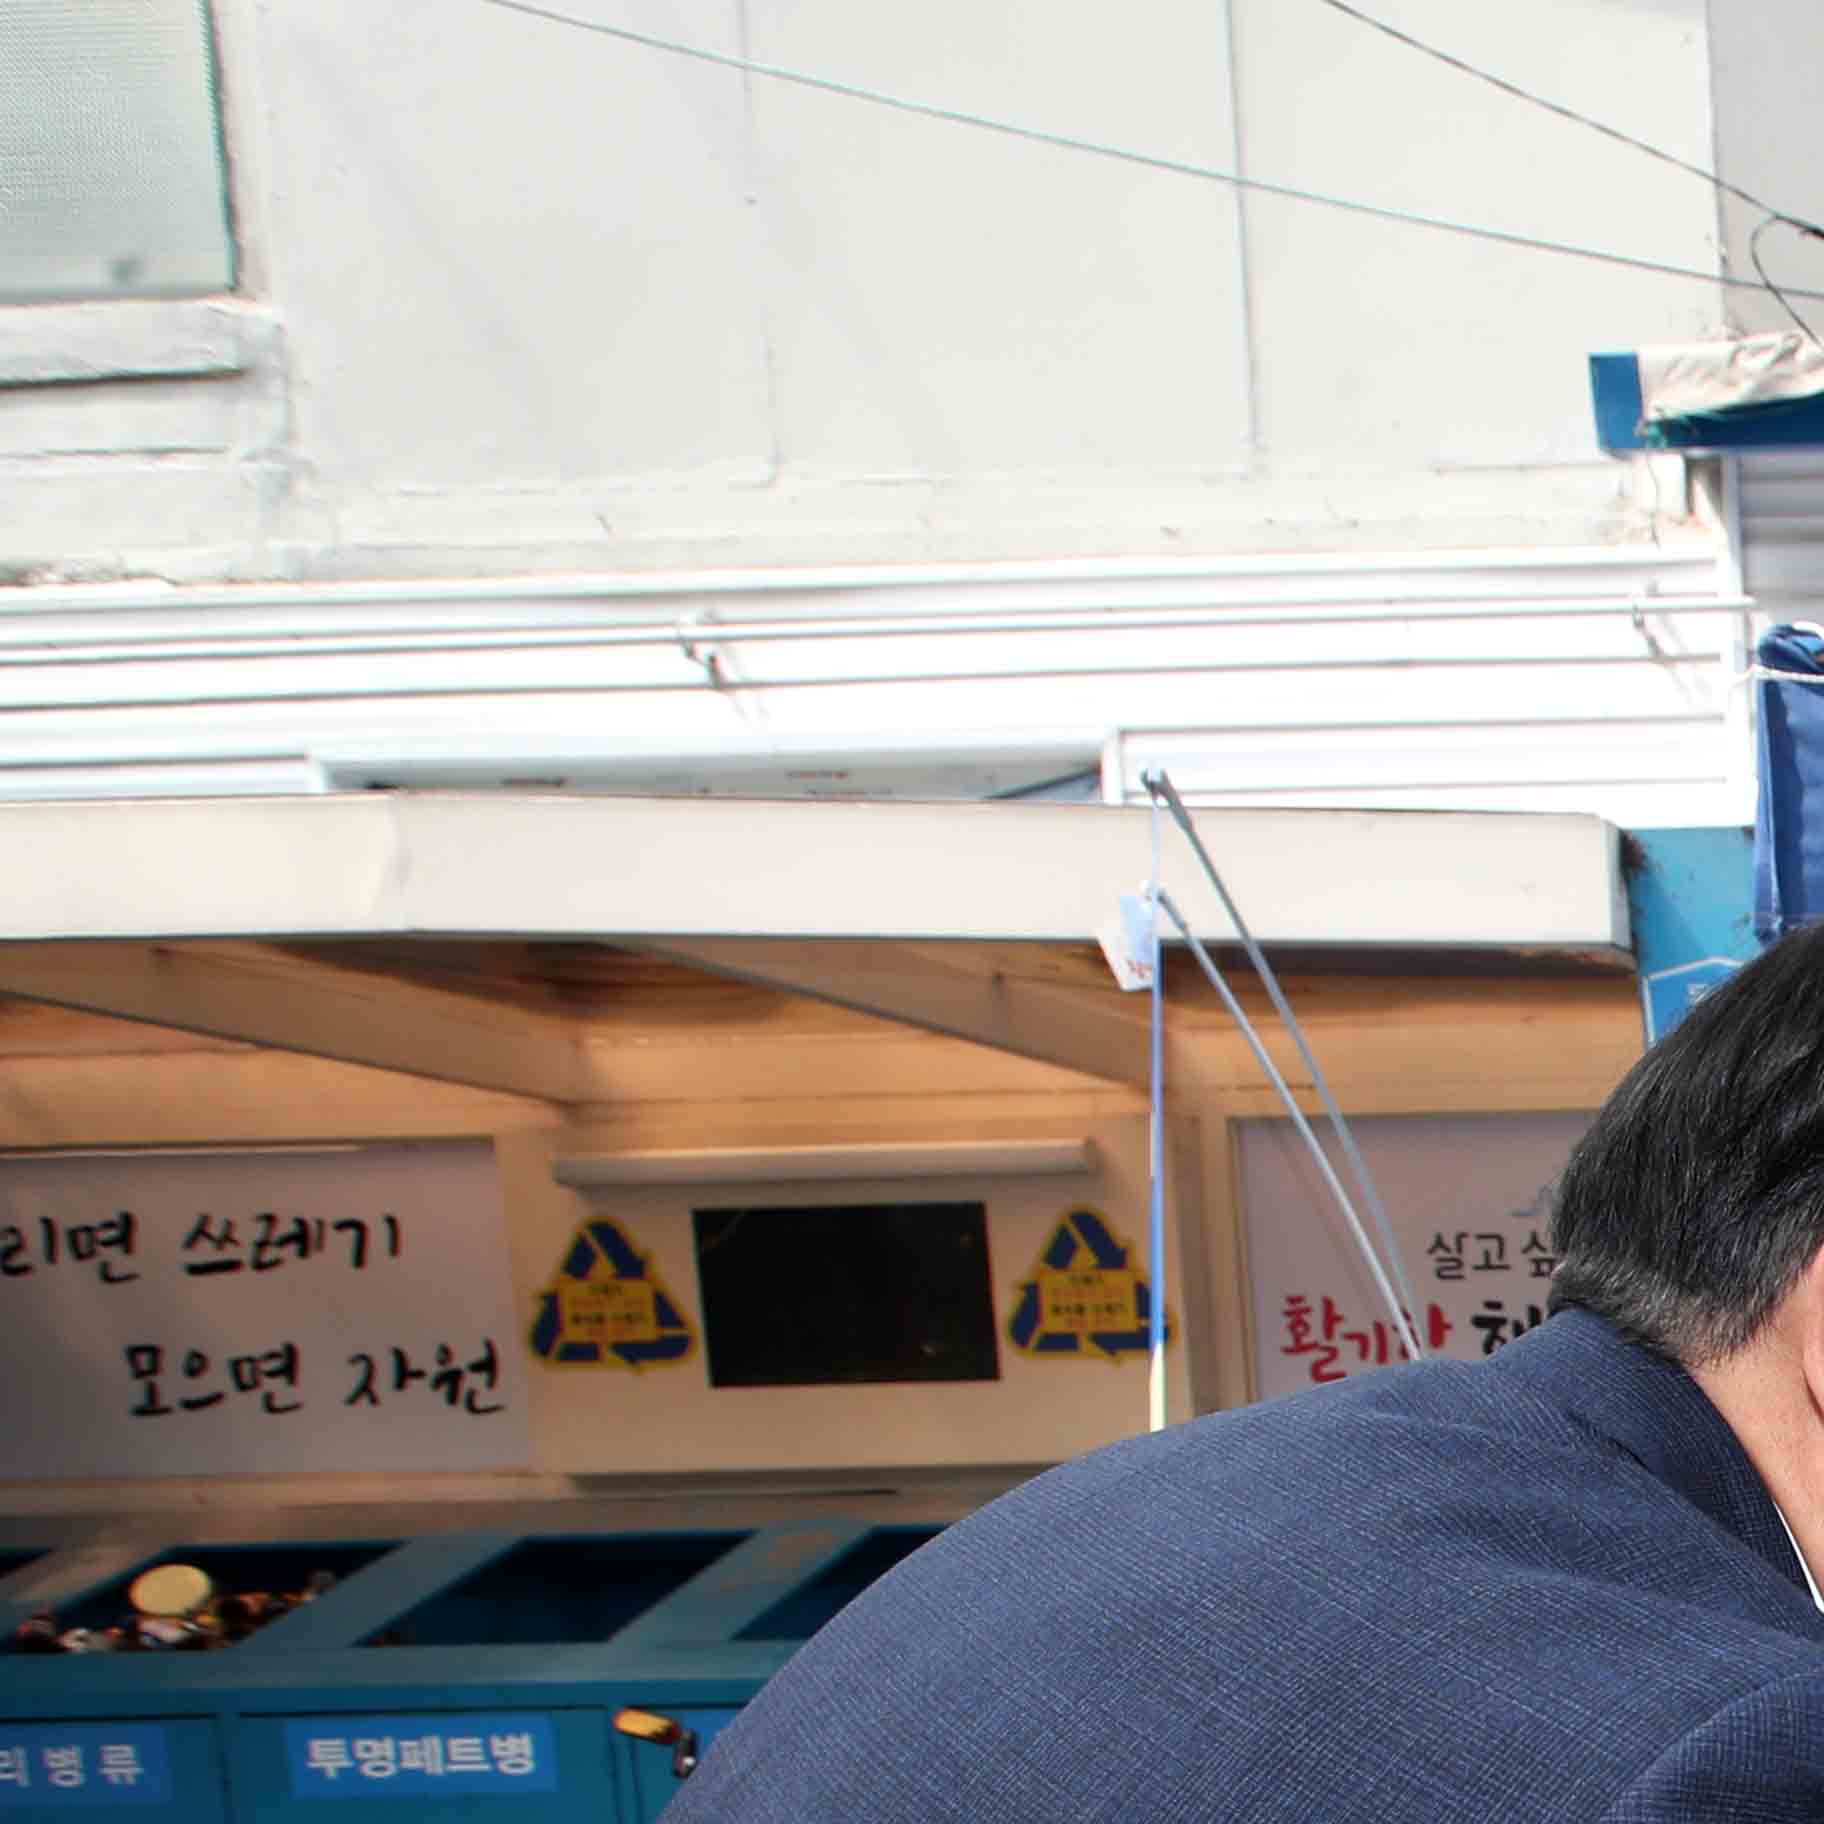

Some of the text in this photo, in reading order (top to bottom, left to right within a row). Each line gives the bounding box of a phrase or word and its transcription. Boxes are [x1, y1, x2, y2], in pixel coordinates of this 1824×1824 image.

[181, 1213, 400, 1273] 쓰레기
[1427, 1232, 1511, 1280] 살고
[126, 1339, 504, 1416] 모으면 자원
[307, 1733, 535, 1780] 투명페트병
